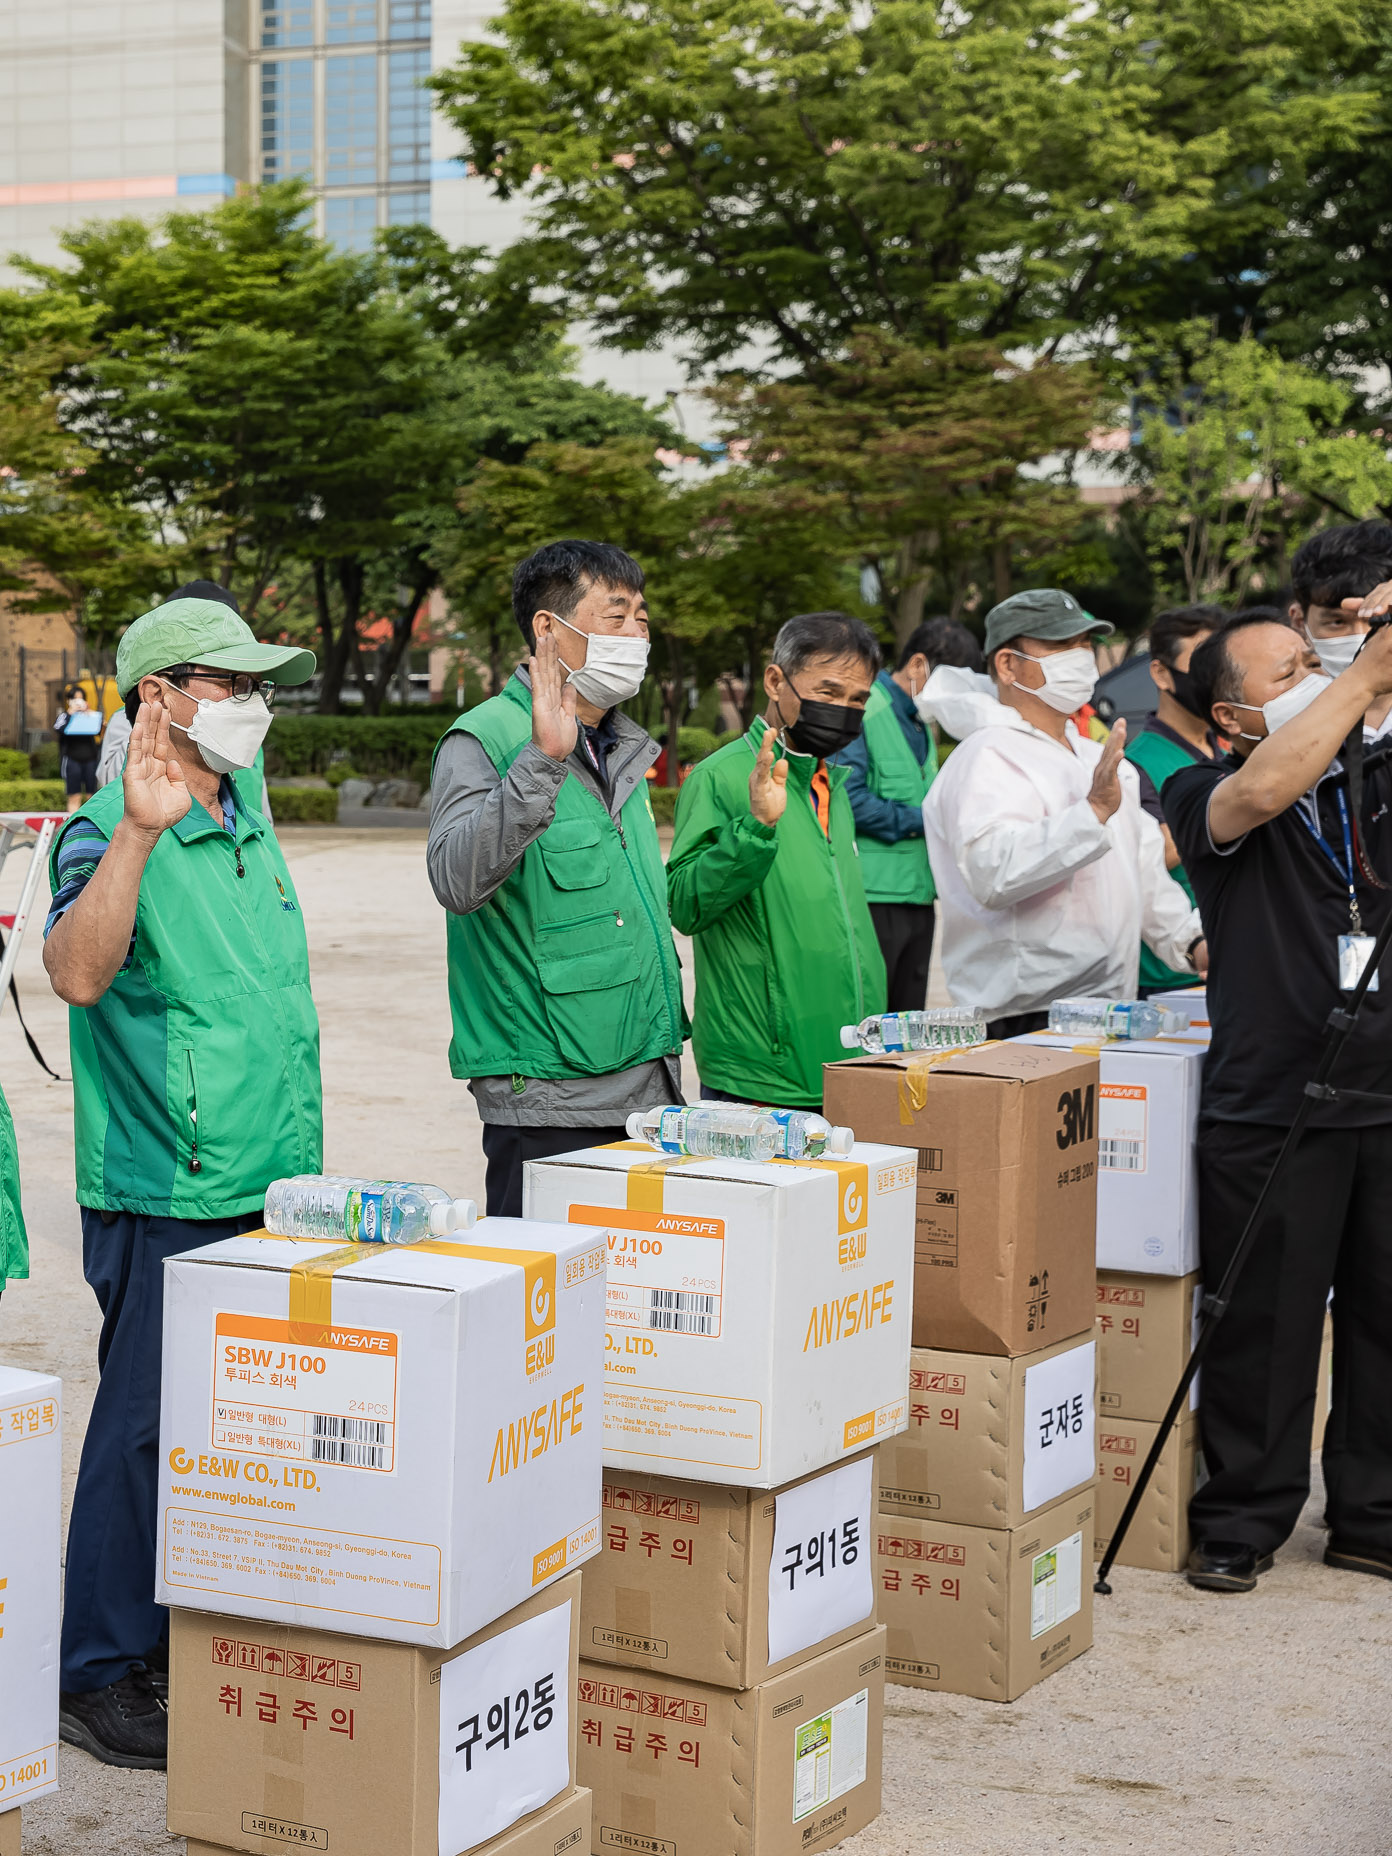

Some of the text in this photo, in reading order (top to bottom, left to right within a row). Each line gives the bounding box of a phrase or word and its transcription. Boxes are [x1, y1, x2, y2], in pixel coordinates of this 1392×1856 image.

[1100, 1087, 1142, 1097] NYSAFE
[1056, 1084, 1094, 1150] 3M
[935, 1191, 954, 1204] 3M
[656, 1219, 718, 1234] ANYSAFE
[620, 1237, 662, 1255] J100
[839, 1232, 866, 1265] E&W
[565, 1256, 585, 1285] 일회용
[614, 1255, 637, 1269] 회색
[803, 1280, 894, 1352] ANYSAFE
[319, 1332, 389, 1350] ANYSAFE
[526, 1333, 554, 1376] E&W
[626, 1336, 657, 1357] LTD.
[225, 1346, 326, 1374] SBW J100
[225, 1368, 296, 1390] 투피스 회색
[529, 1369, 552, 1384] EVERWELL
[10, 1403, 55, 1435] 작업복
[228, 1410, 287, 1427] 일반형 대형(L)
[719, 1406, 736, 1414] Korea
[878, 1410, 886, 1427] ISO
[1040, 1394, 1083, 1448] 군자동
[228, 1431, 300, 1451] 일반형 특대형(XL)
[488, 1384, 584, 1483] ANYSAFE
[729, 1432, 753, 1440] Vietnam
[848, 1420, 872, 1440] ISO 9001
[198, 1455, 320, 1492] E&W CO., LTD.
[172, 1485, 295, 1511] www.enwglobal.com
[172, 1518, 185, 1526] Add
[303, 1538, 343, 1550] Anseong-si,
[392, 1551, 412, 1560] Korea
[172, 1527, 183, 1535] Tel
[234, 1536, 248, 1545] 3875
[254, 1540, 265, 1548] Fax
[316, 1548, 331, 1557] 9852
[570, 1527, 598, 1556] ISO 14001
[172, 1546, 185, 1554] Add
[212, 1552, 231, 1561] Street
[241, 1556, 256, 1564] VSIP
[267, 1560, 279, 1568] Thu
[281, 1562, 293, 1571] Dau
[296, 1565, 307, 1573] Mot
[310, 1567, 323, 1576] City
[329, 1569, 343, 1578] Binh
[346, 1572, 366, 1582] Duong
[403, 1581, 430, 1590] Vietnam
[537, 1547, 563, 1577] ISO 9001
[782, 1517, 860, 1591] 구의1동
[172, 1554, 182, 1562] Tel
[237, 1564, 251, 1573] 6002
[255, 1567, 266, 1575] Fax
[321, 1576, 336, 1586] 6004
[196, 1574, 219, 1582] Vietnam
[456, 1672, 555, 1772] 구의2동
[9, 1758, 48, 1787] 14001
